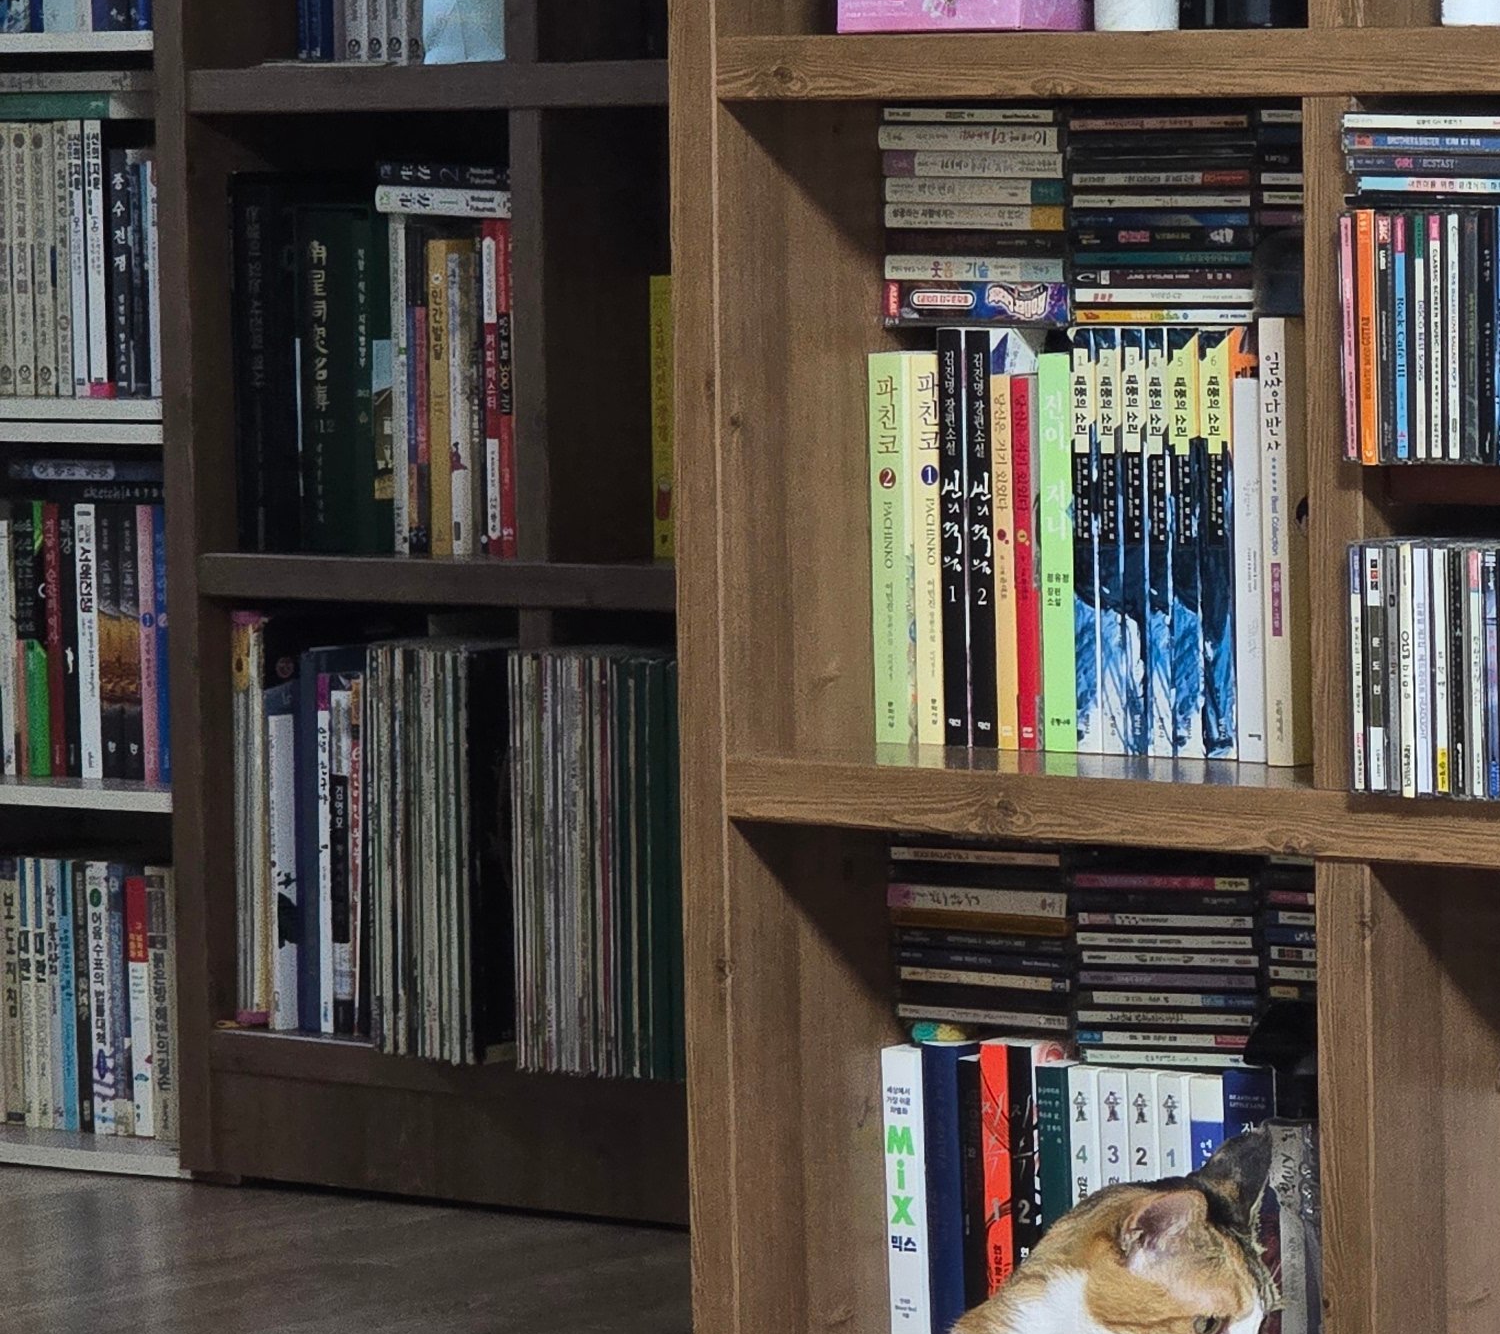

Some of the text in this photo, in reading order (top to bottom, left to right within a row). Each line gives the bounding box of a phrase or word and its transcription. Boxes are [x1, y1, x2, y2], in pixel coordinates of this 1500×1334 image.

[1396, 297, 1405, 327] Rock
[876, 375, 899, 456] 파친코
[916, 372, 939, 452] 파친코
[944, 350, 956, 456] 김진명 장편소설
[1264, 352, 1284, 452] 일쌍다반사
[882, 500, 893, 569] PACHINKO
[1046, 573, 1069, 584] 정유정
[1075, 1144, 1089, 1164] 4
[1107, 1144, 1121, 1164] 3
[891, 1234, 918, 1253] 믹스
